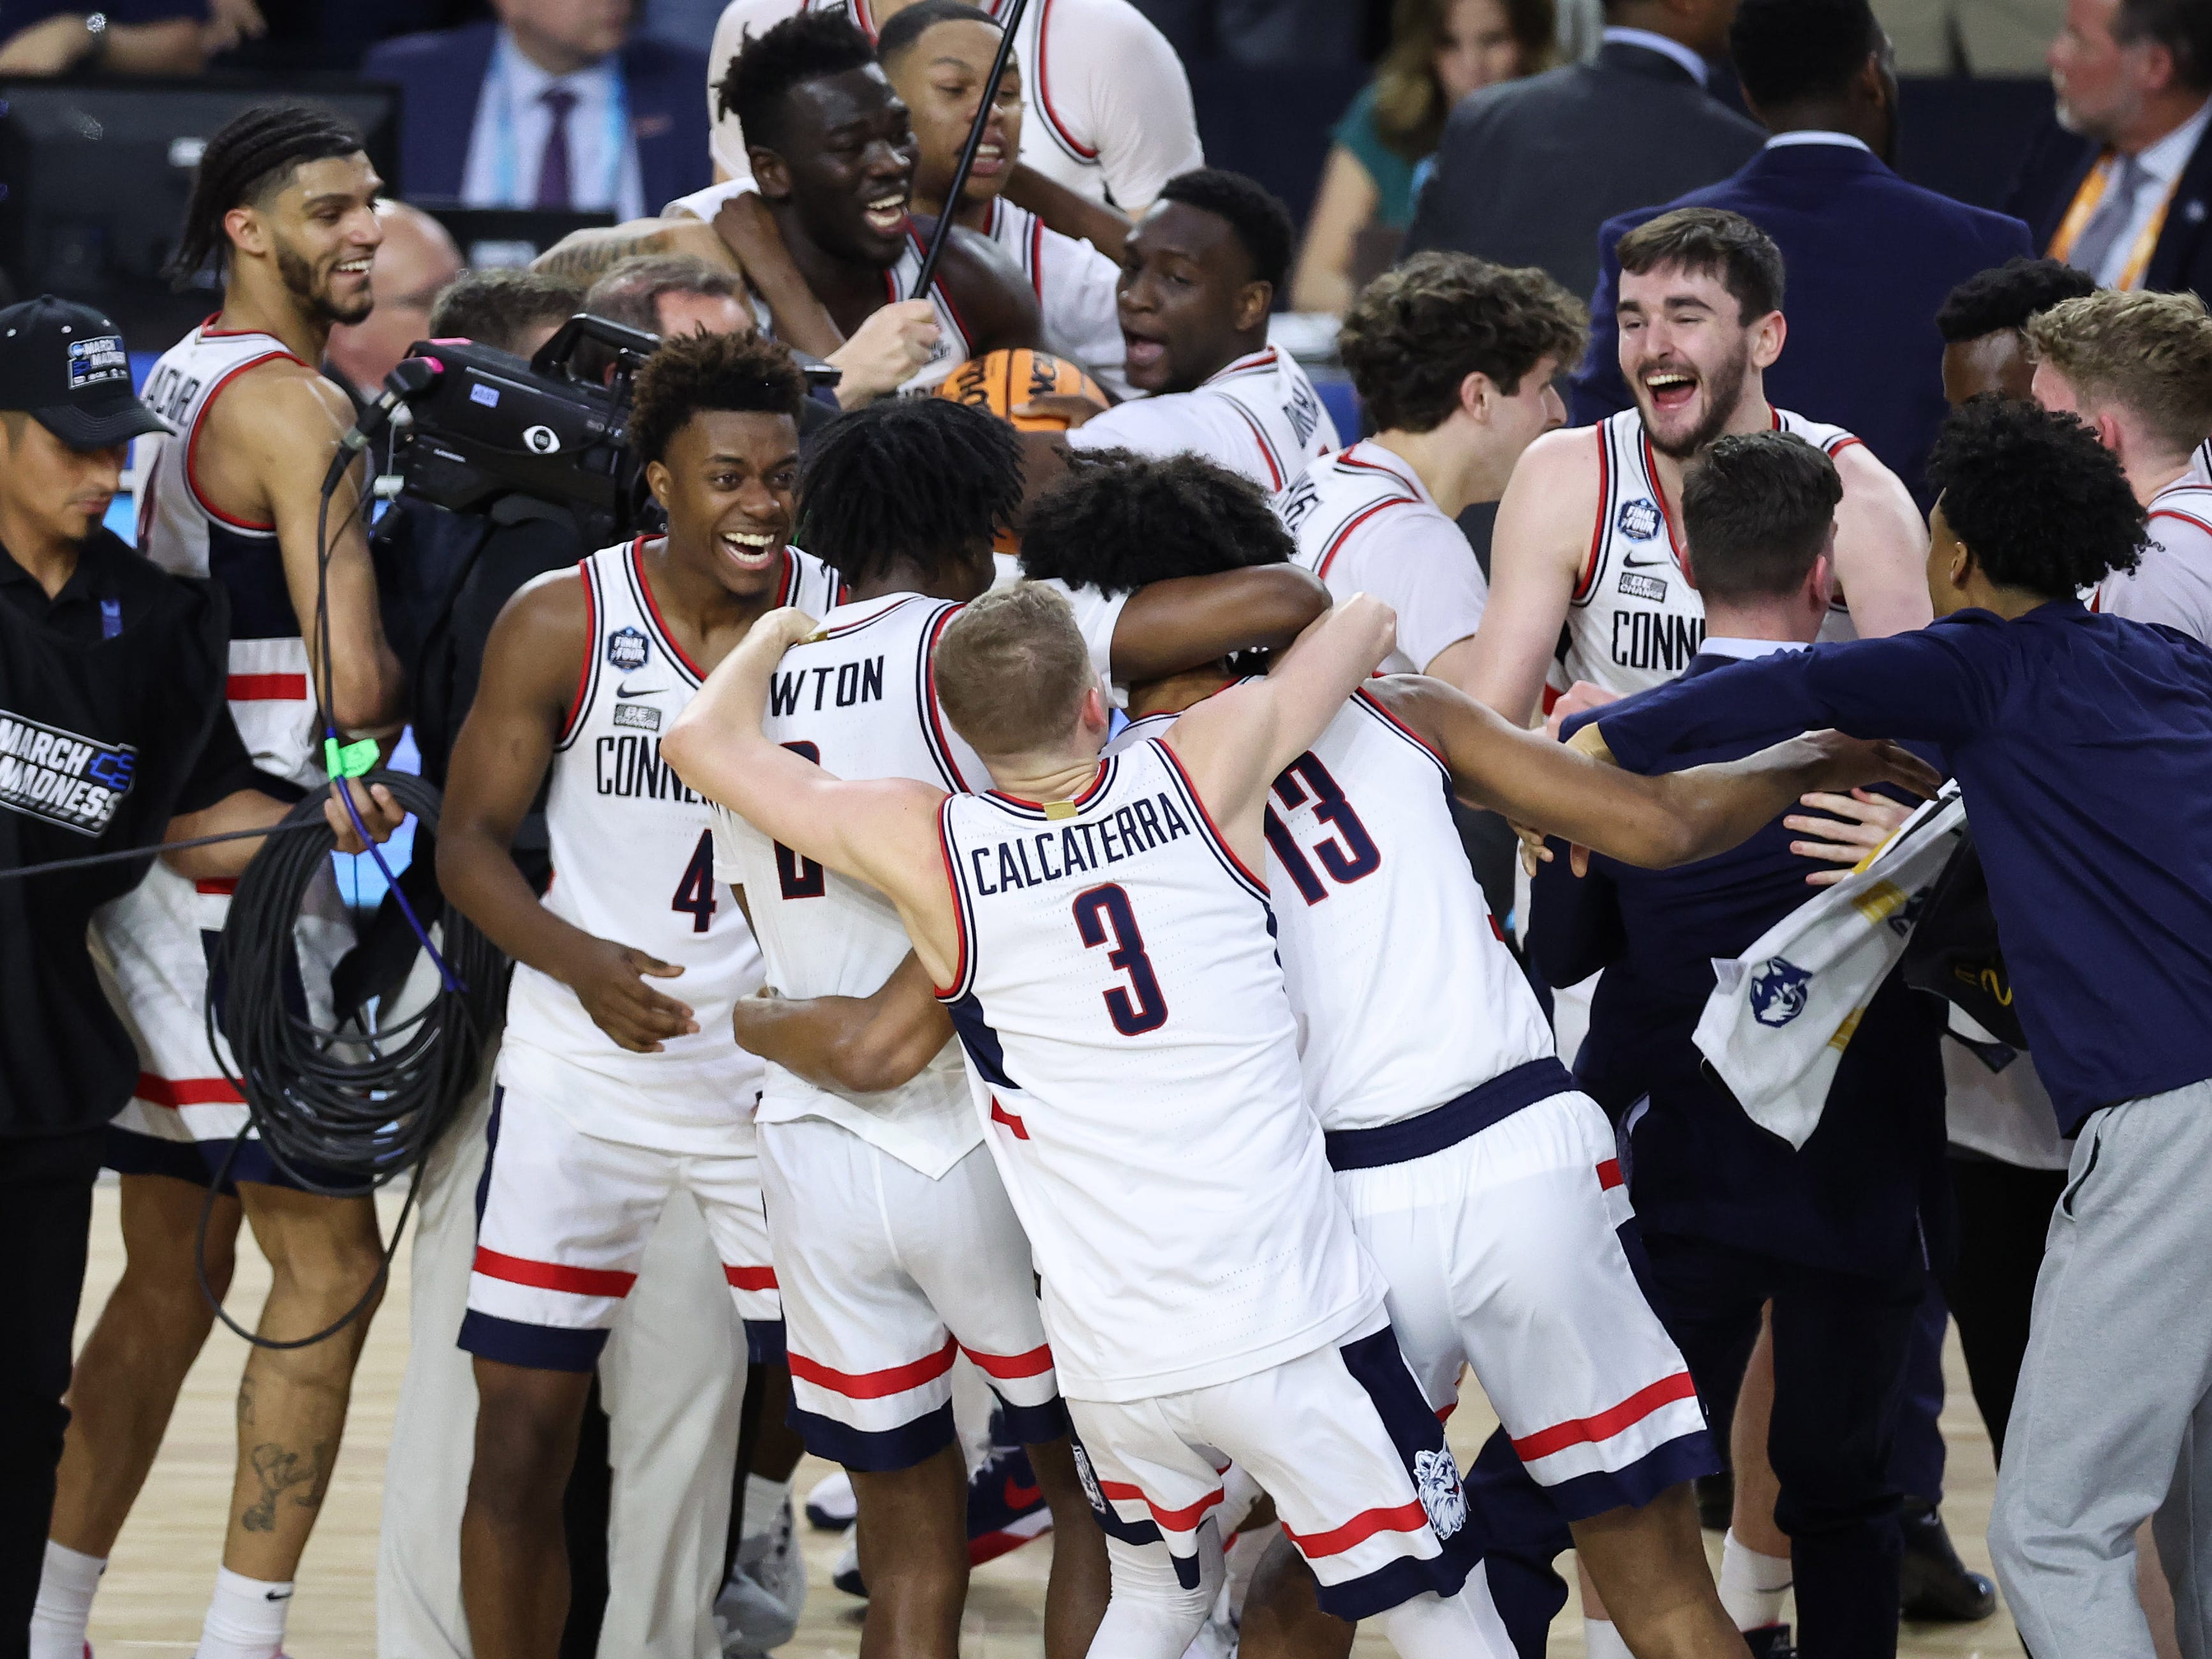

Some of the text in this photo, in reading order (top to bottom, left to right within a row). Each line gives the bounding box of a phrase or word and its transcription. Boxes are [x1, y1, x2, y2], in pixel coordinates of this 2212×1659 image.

[770, 654, 884, 717] WTON
[0, 718, 94, 777] MARCH
[0, 755, 123, 821] MADNESS
[596, 735, 708, 805] CONN
[971, 792, 1191, 896] CALCATERRA
[1264, 750, 1381, 907] 13
[672, 828, 717, 933] 4
[1072, 882, 1169, 1037] 3
